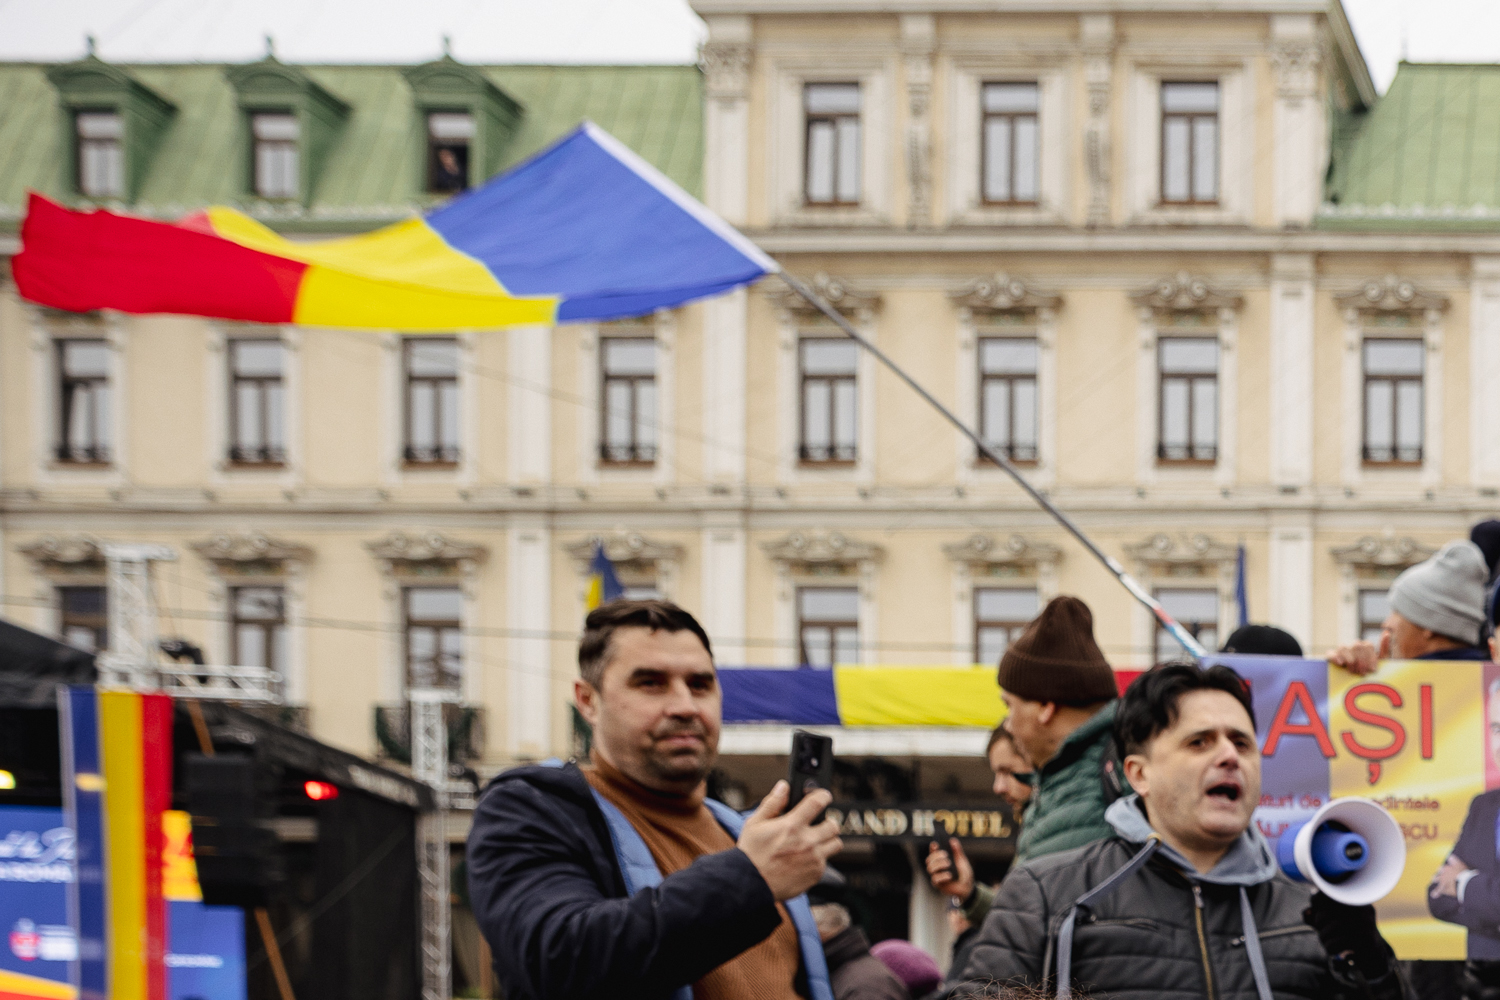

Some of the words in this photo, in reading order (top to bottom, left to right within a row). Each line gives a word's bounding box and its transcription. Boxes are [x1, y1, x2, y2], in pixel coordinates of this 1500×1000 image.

[1240, 680, 1434, 784] AȘI
[825, 808, 909, 837] RAND
[911, 808, 1012, 838] HOTEL
